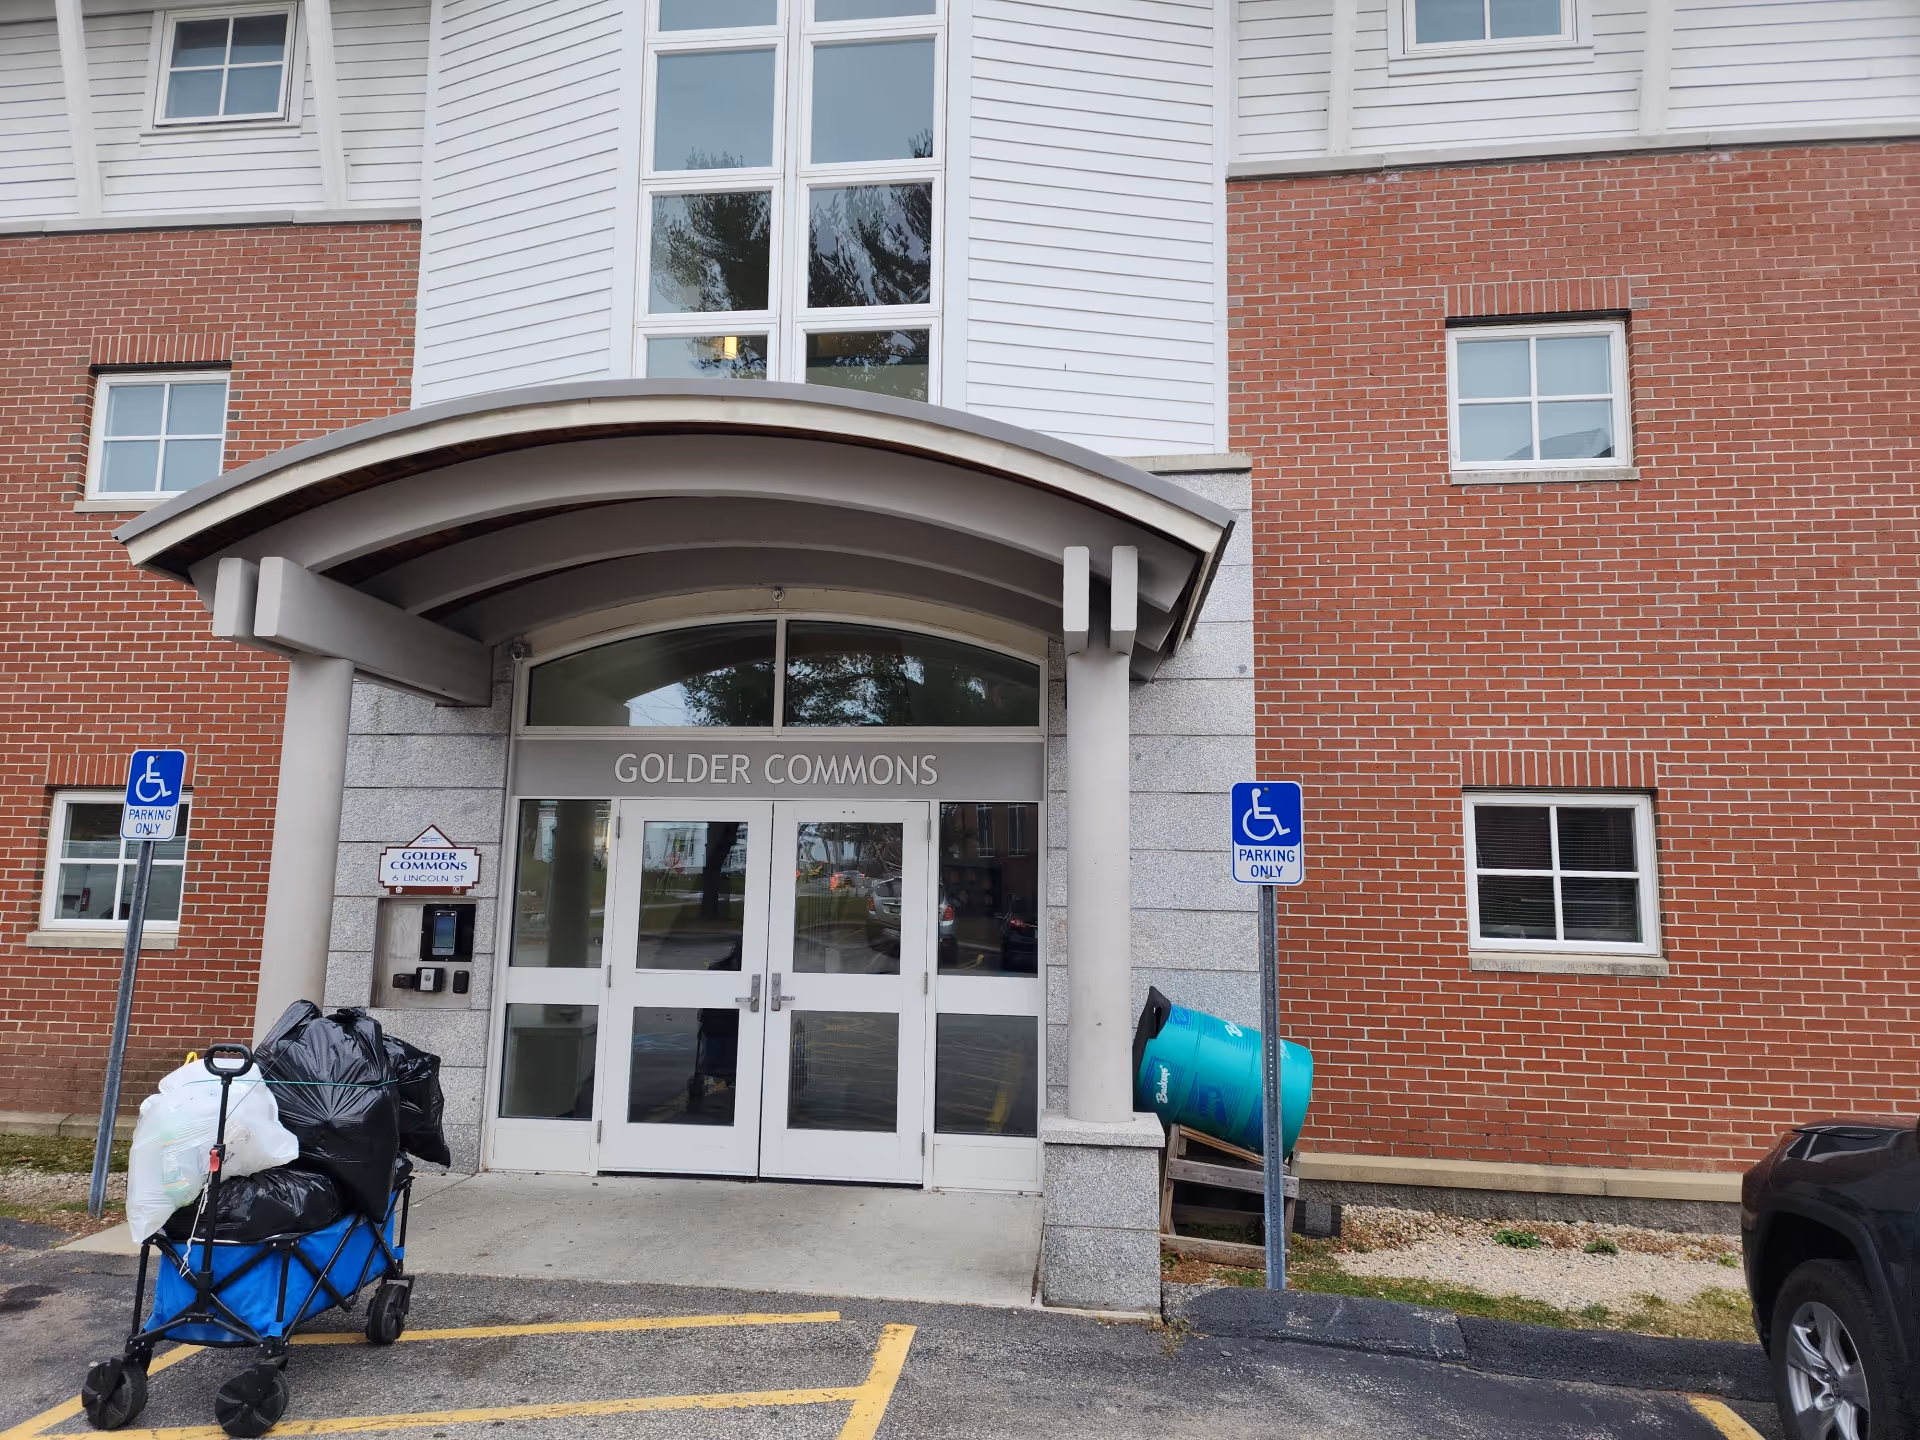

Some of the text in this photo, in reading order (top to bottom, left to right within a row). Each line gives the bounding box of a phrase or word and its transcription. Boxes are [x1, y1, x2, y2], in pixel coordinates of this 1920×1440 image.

[614, 753, 939, 785] GOLDER COMMONS
[128, 808, 172, 821] PARKING
[135, 822, 161, 835] ONLY
[401, 851, 457, 861] GOLDER
[1239, 849, 1295, 863] PARKING
[390, 861, 468, 871] COMMONS
[1250, 864, 1284, 878] ONLY
[392, 874, 465, 883] 6 LINCOLN ST
